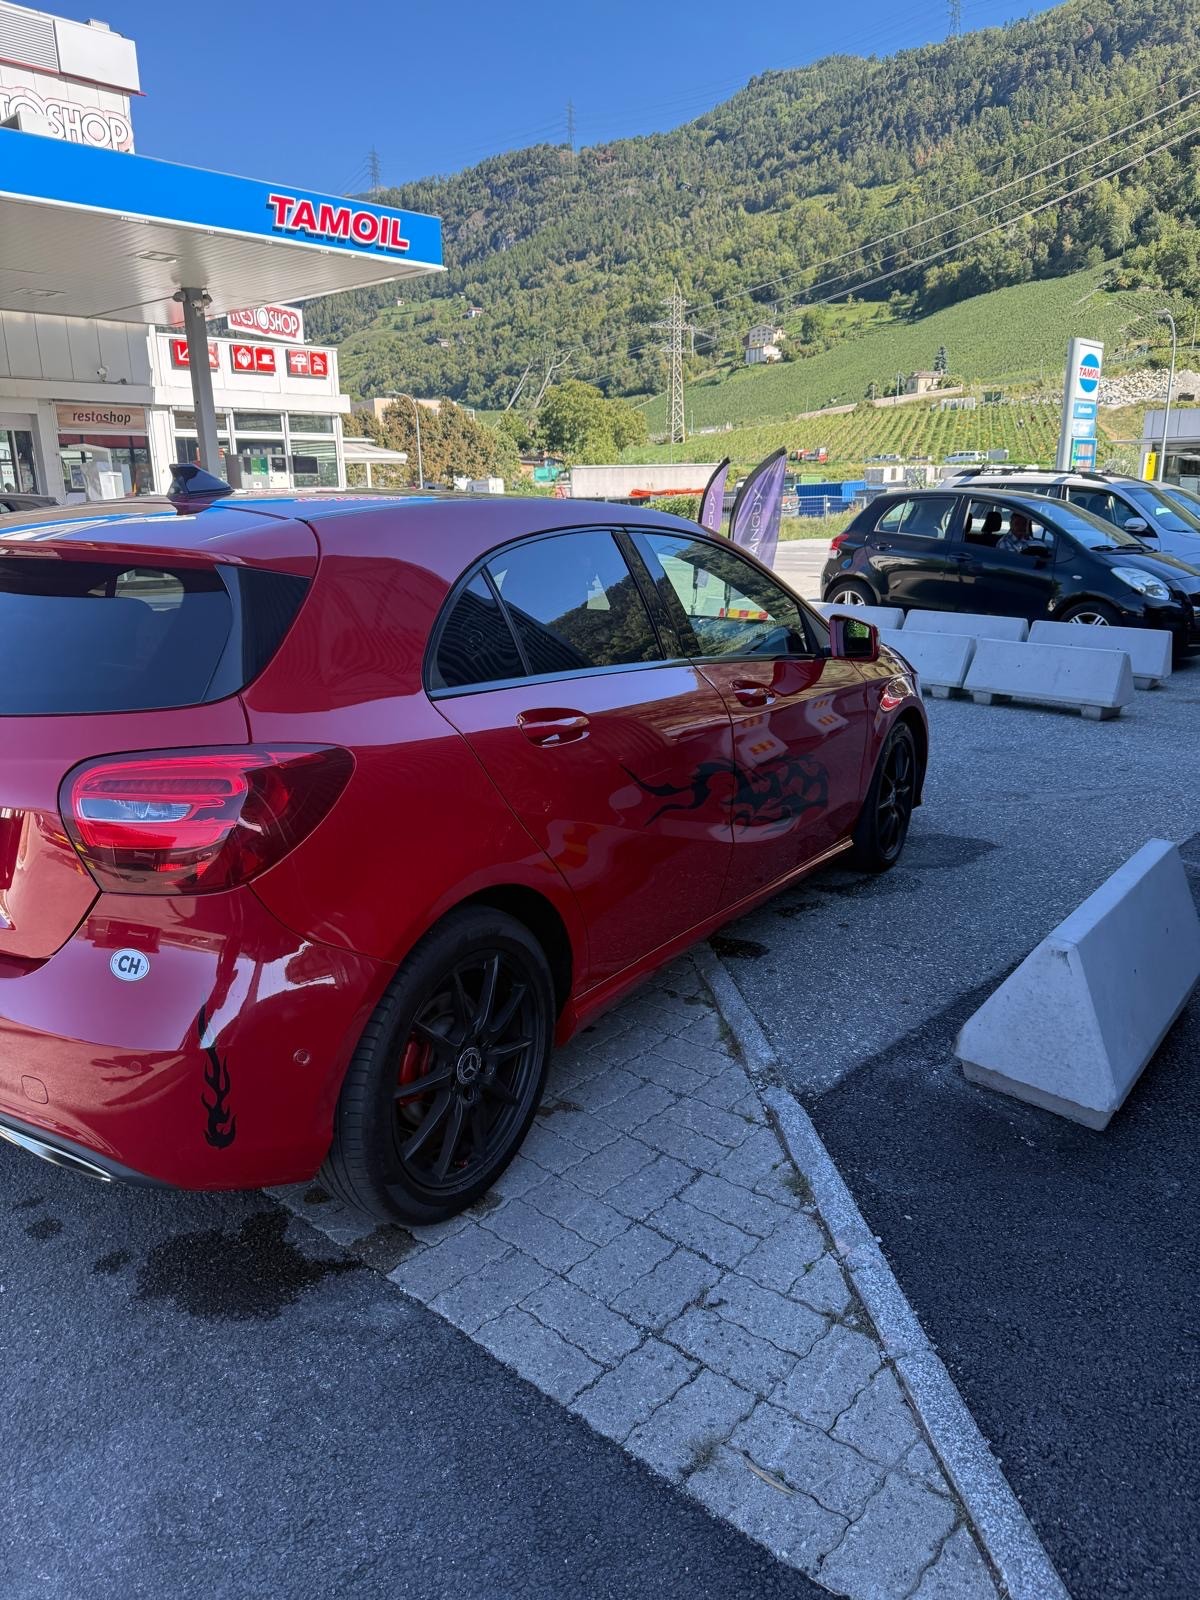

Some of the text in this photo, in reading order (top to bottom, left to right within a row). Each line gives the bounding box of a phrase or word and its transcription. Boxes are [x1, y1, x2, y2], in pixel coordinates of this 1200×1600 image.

[269, 193, 410, 250] TAMOIL
[72, 411, 131, 425] restoshop
[117, 955, 142, 975] CH
